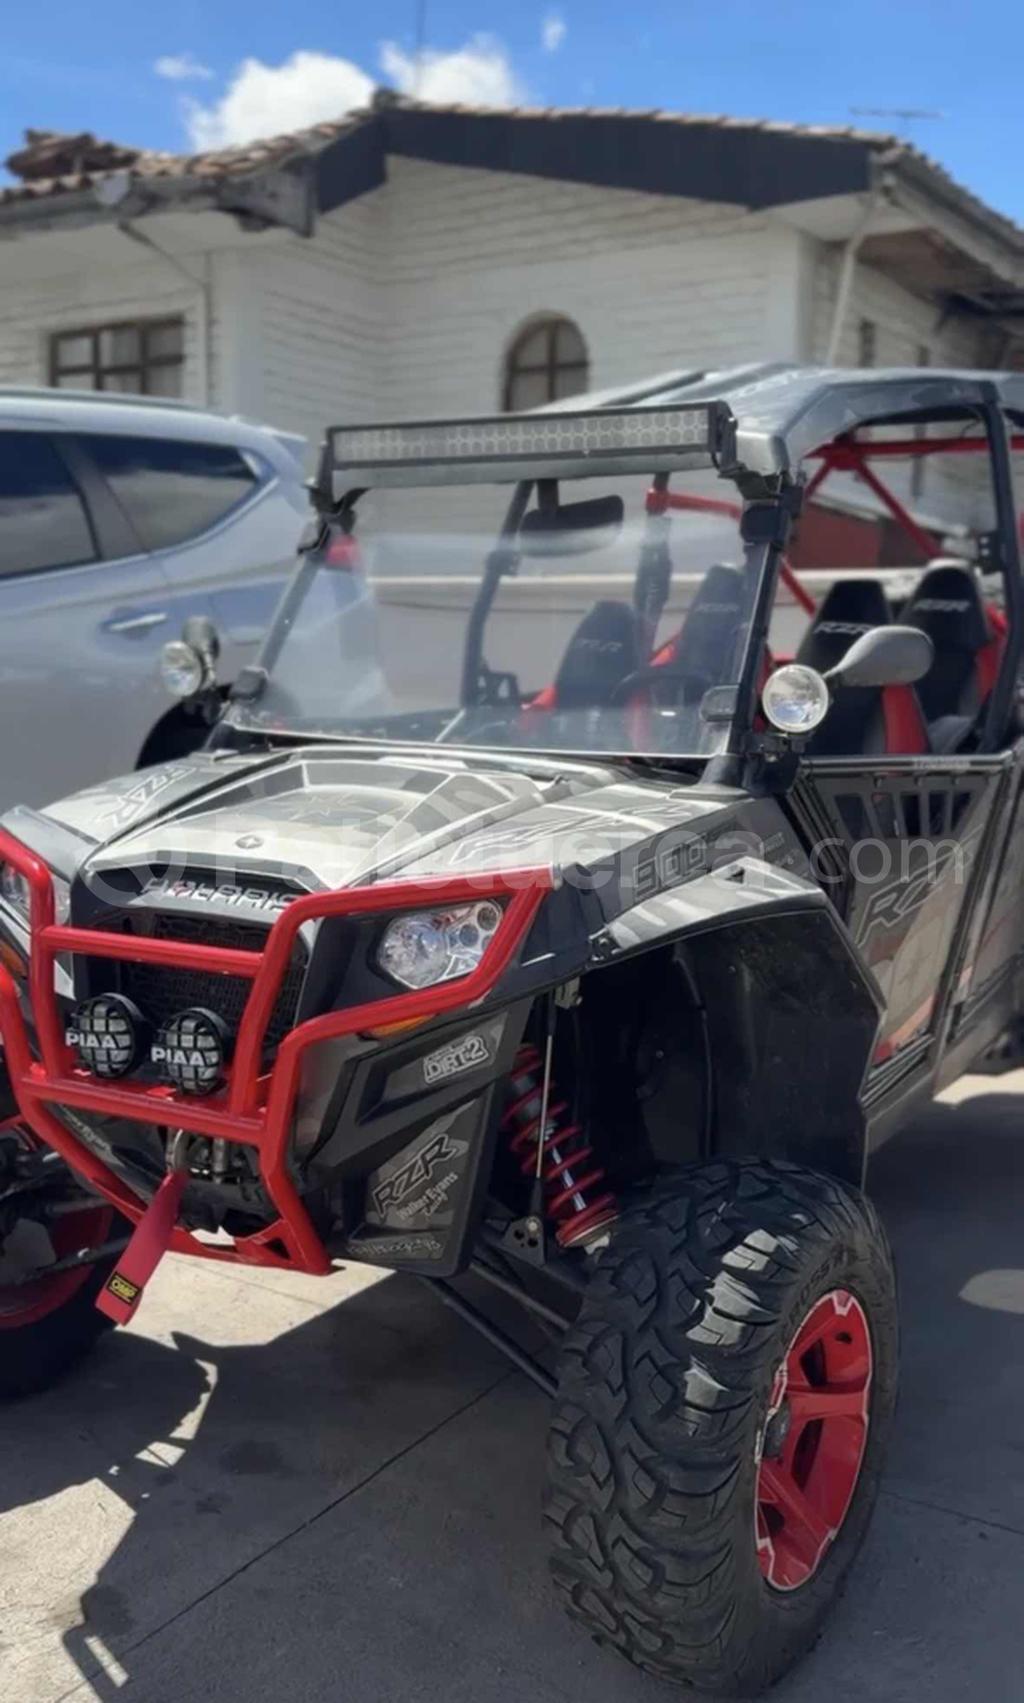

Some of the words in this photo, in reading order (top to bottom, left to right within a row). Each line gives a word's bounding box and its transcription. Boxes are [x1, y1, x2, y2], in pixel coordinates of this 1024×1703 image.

[139, 877, 302, 912] POLARIS
[65, 1031, 117, 1049] PIAA
[151, 1046, 205, 1067] PIAA
[373, 1133, 457, 1219] RZR
